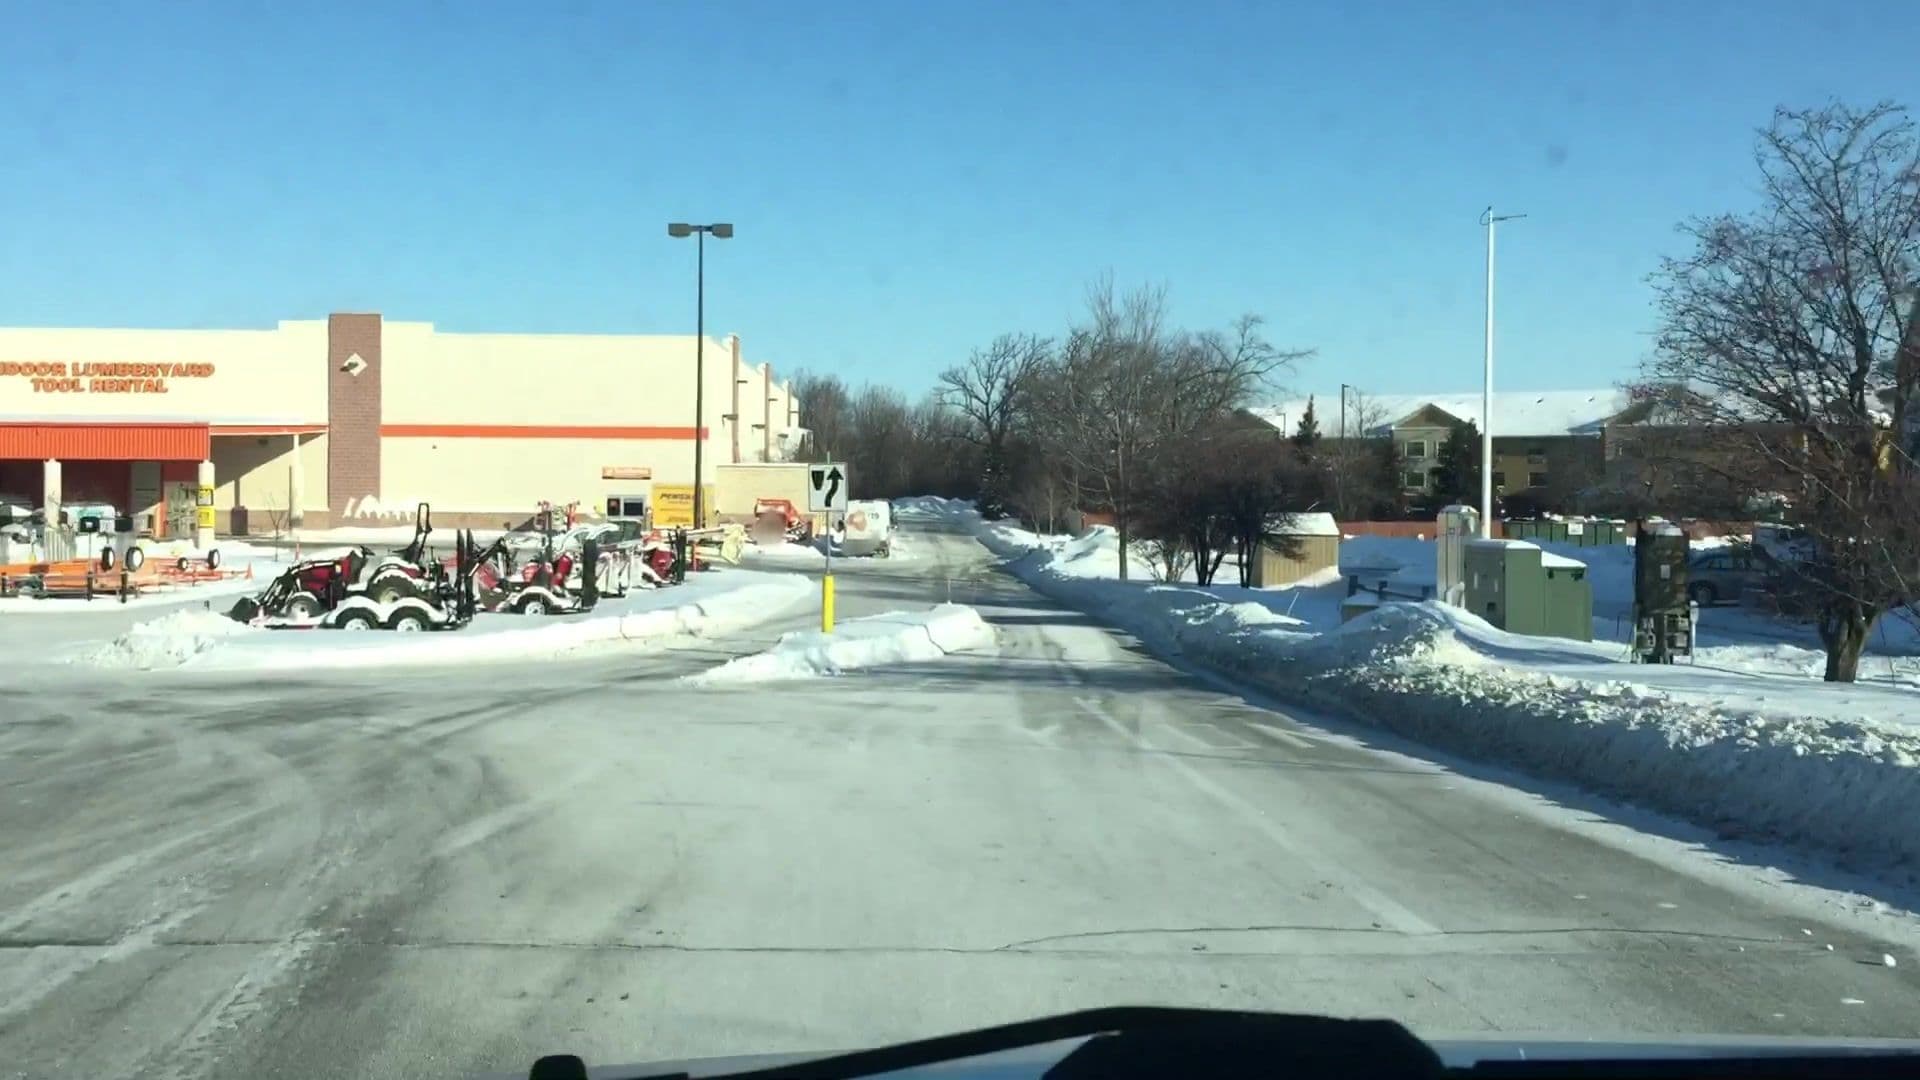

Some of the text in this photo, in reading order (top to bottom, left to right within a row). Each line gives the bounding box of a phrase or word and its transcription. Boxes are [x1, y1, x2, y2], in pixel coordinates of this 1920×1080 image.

[72, 362, 215, 377] LUMBERYARD
[31, 378, 168, 393] TOOL RENTAL
